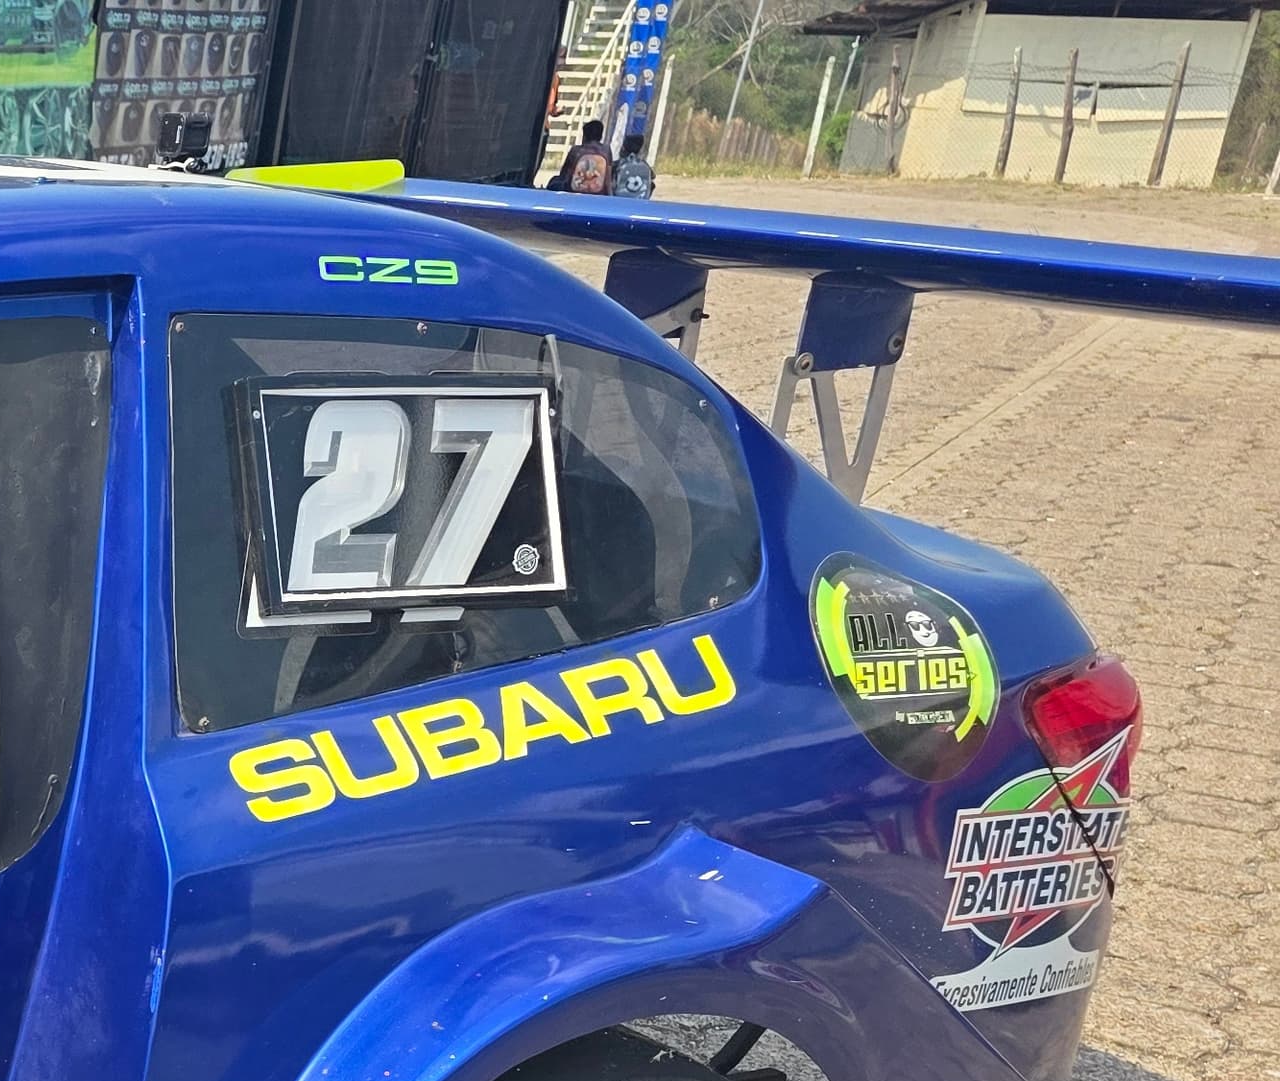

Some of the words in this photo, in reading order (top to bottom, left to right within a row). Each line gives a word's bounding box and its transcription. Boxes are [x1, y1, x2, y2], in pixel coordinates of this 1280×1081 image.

[319, 256, 459, 285] CZ9
[287, 399, 534, 588] 27
[848, 612, 909, 652] ALL
[855, 652, 969, 695] series
[228, 633, 738, 823] SUBARU
[954, 858, 1116, 917] BATTERIES
